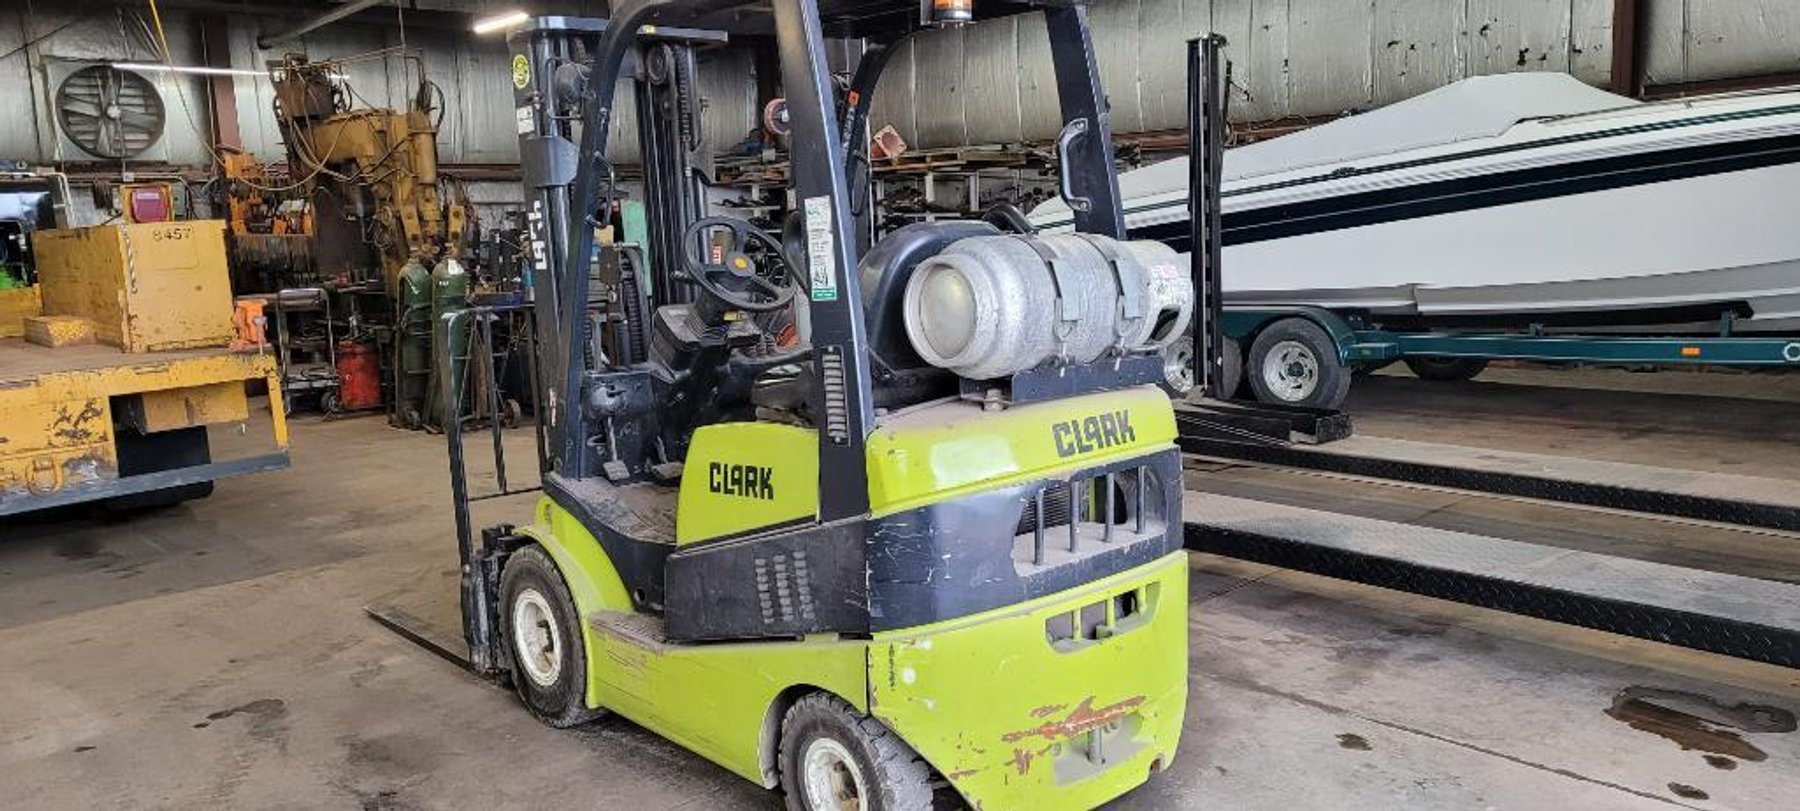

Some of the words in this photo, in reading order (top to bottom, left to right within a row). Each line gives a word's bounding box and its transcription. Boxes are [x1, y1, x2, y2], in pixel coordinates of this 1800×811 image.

[153, 228, 191, 242] 8457
[1052, 409, 1136, 458] CLARK
[709, 462, 774, 501] CLARK
